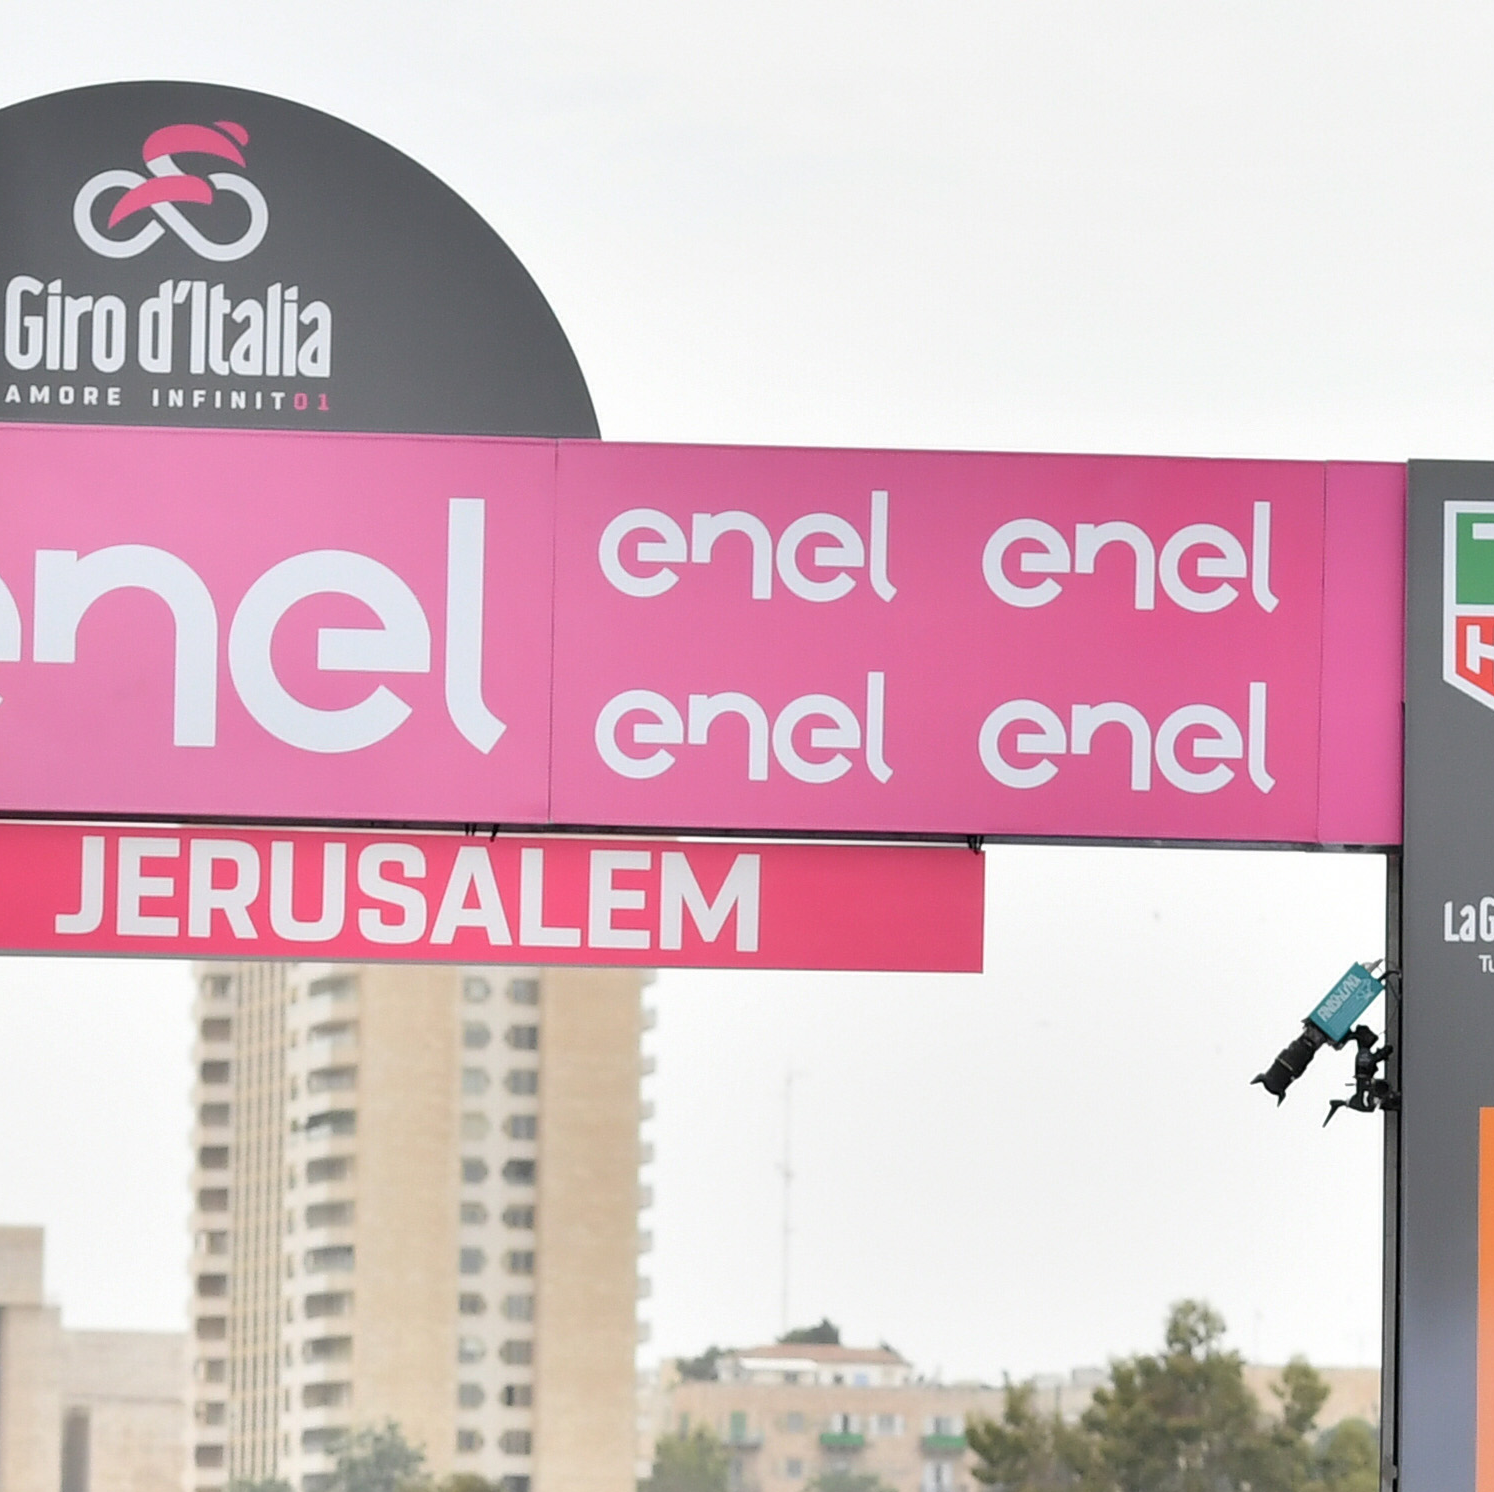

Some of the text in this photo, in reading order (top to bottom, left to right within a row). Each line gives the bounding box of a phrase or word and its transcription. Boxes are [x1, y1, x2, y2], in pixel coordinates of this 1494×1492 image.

[5, 275, 332, 378] Giro d'Italia
[5, 384, 122, 406] AMORE
[598, 490, 897, 602] enel
[982, 501, 1279, 613] enel
[595, 671, 893, 784] enel
[978, 682, 1275, 794] enel
[54, 835, 761, 953] JERUSALEM
[1444, 900, 1476, 944] La
